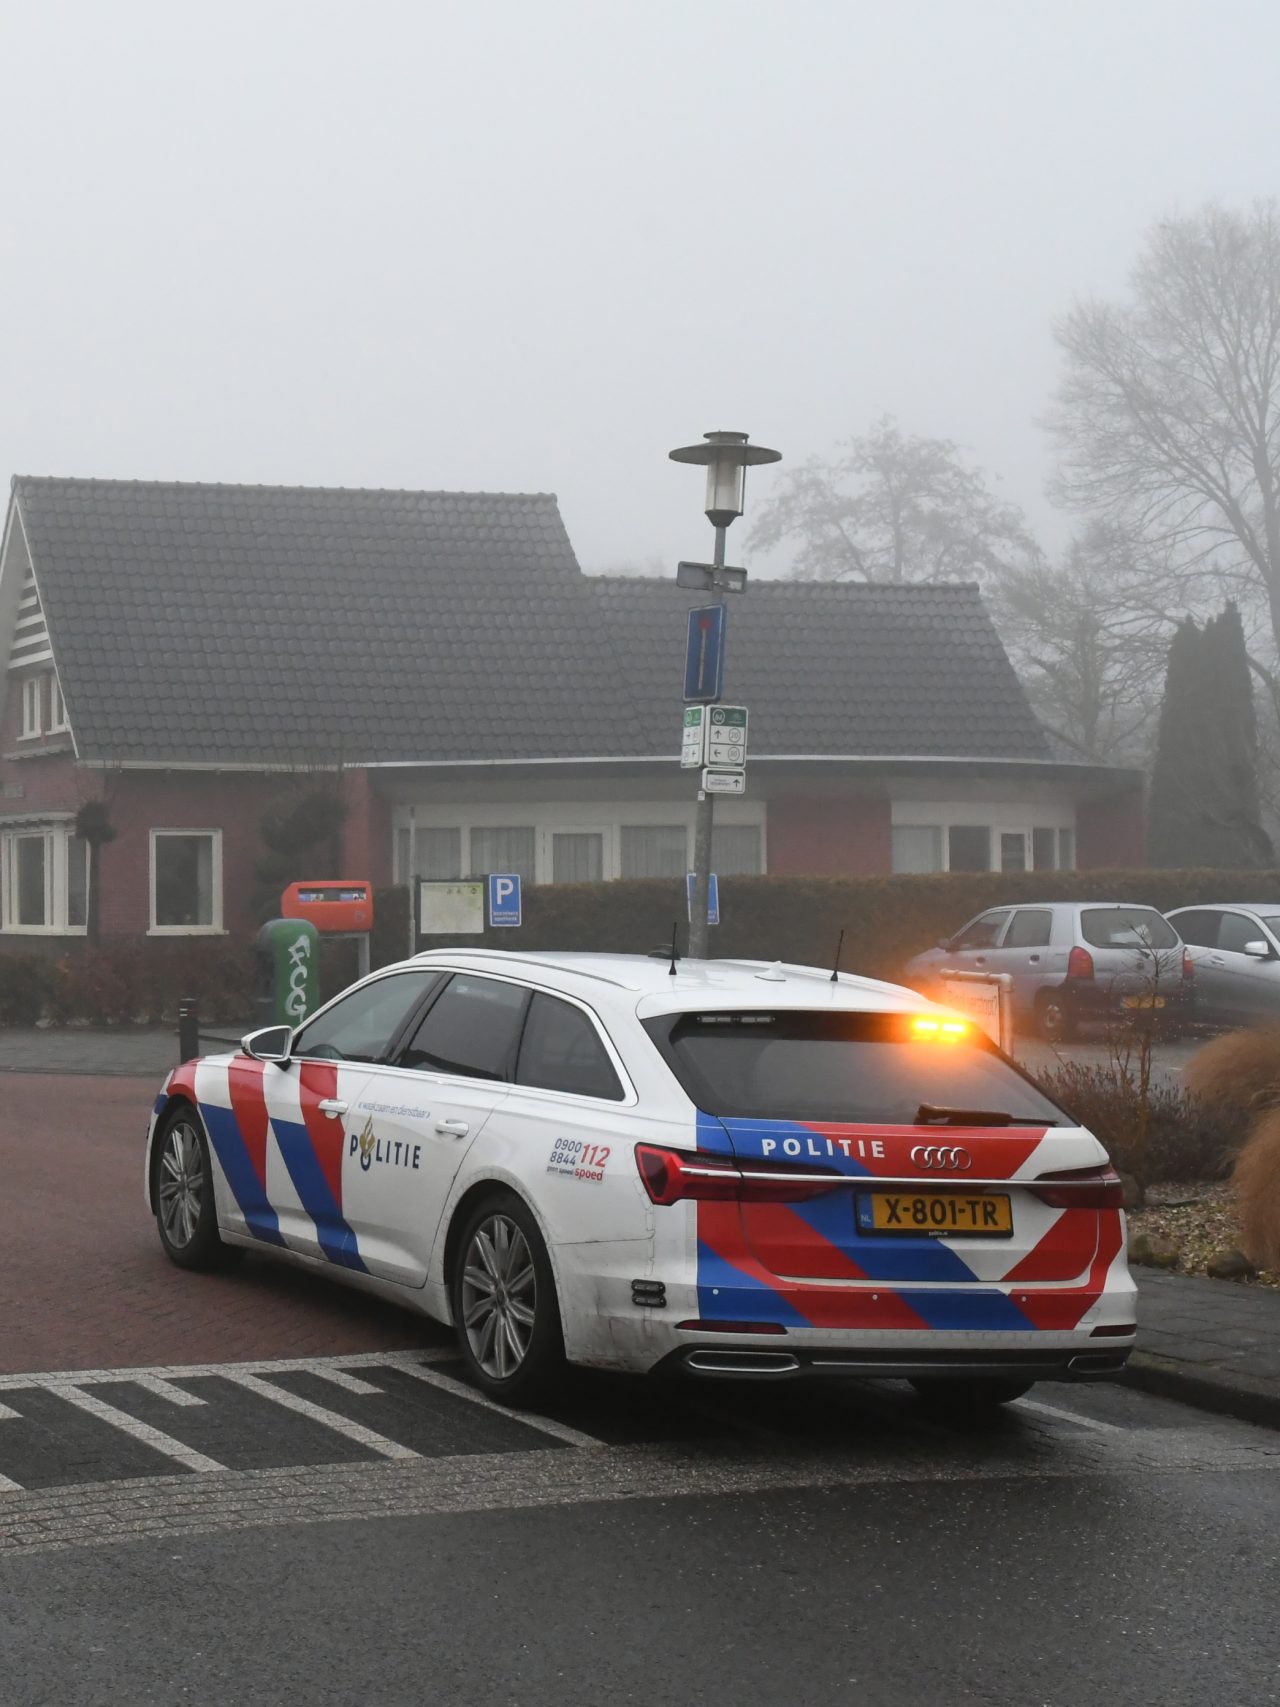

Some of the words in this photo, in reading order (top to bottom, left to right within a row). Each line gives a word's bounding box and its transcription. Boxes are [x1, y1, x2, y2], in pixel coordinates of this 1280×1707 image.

[496, 878, 514, 905] P
[350, 1134, 421, 1171] POLITIE
[554, 1138, 582, 1153] 0900
[581, 1144, 611, 1167] 112
[761, 1138, 885, 1158] POLITIE
[549, 1151, 576, 1166] 8844
[574, 1168, 604, 1181] spoed
[885, 1198, 998, 1226] X-801-TR
